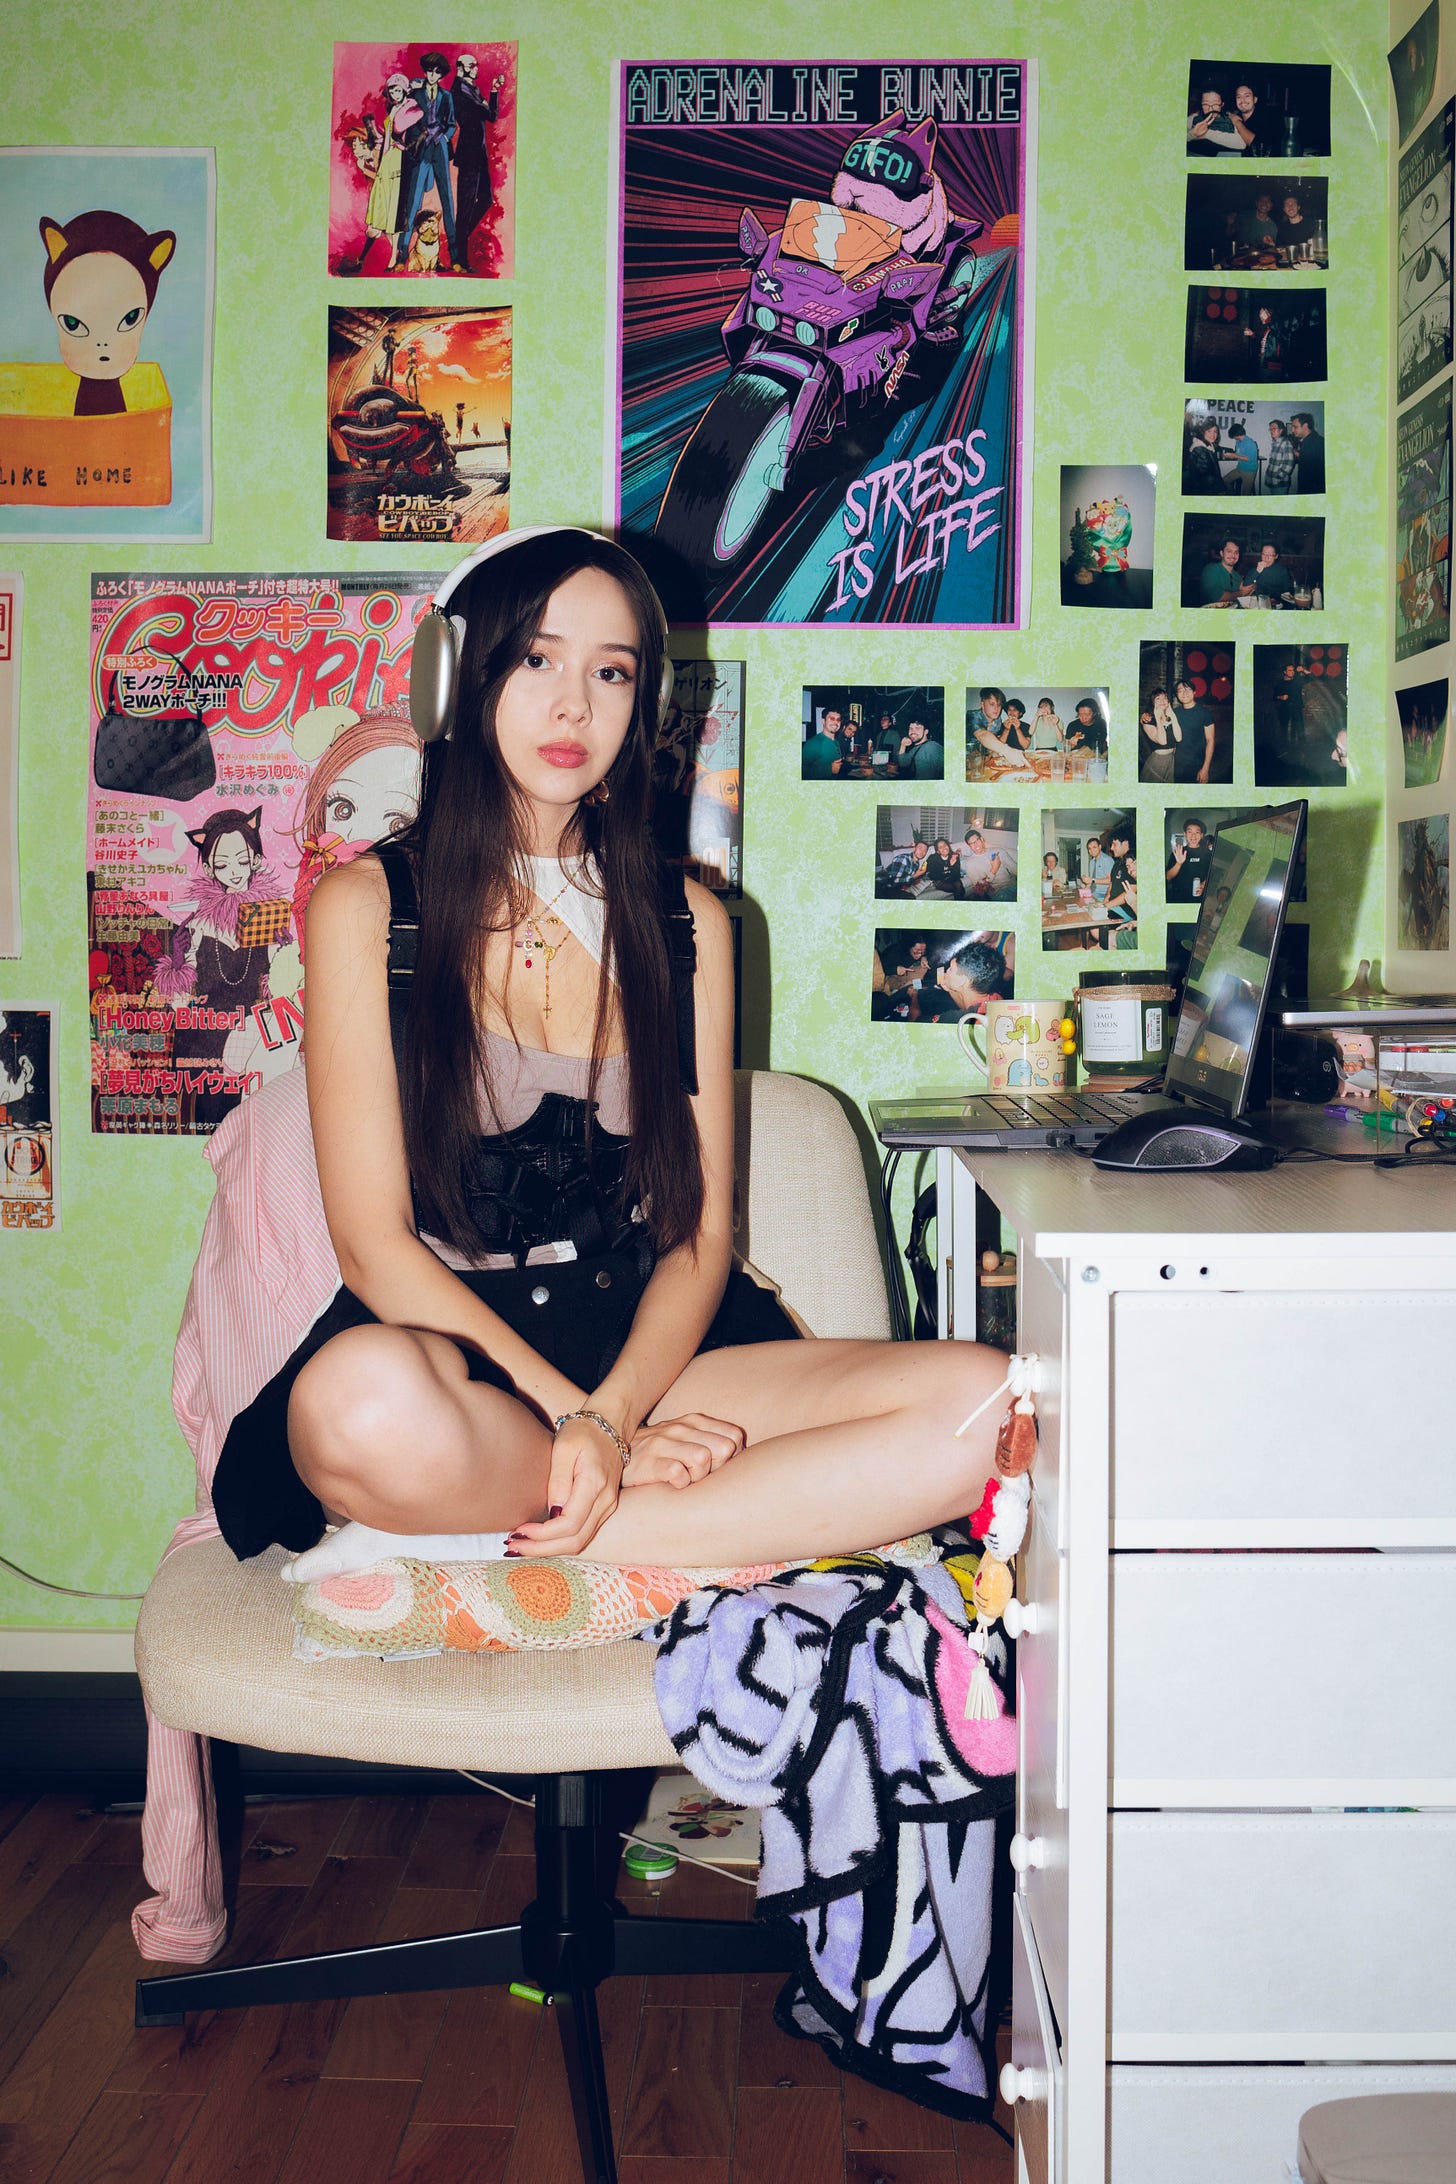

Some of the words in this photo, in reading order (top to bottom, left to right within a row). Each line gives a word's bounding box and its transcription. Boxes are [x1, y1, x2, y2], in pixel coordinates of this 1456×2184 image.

[627, 67, 858, 122] ADRENALINE
[880, 67, 1020, 122] BUNNIE
[844, 142, 912, 185] GTFO!
[865, 258, 911, 286] YAMAHA
[890, 276, 914, 293] PRAY
[1207, 399, 1255, 414] PEACE
[0, 463, 48, 487] LIKE
[75, 466, 132, 486] HOME
[843, 429, 987, 537] STRESS
[377, 493, 455, 512] カウボーイ
[377, 514, 456, 533] ビバップ
[825, 541, 875, 612] IS
[895, 486, 1005, 584] LIFE
[92, 614, 109, 624] 420
[193, 596, 345, 647] クッキー
[105, 655, 154, 669] 特別ふろく
[122, 673, 243, 690] モノグラムNANA
[122, 692, 227, 709] 2WAYポーチ!!!
[215, 783, 280, 796] 水沢めぐみ
[95, 850, 138, 861] 谷川史子
